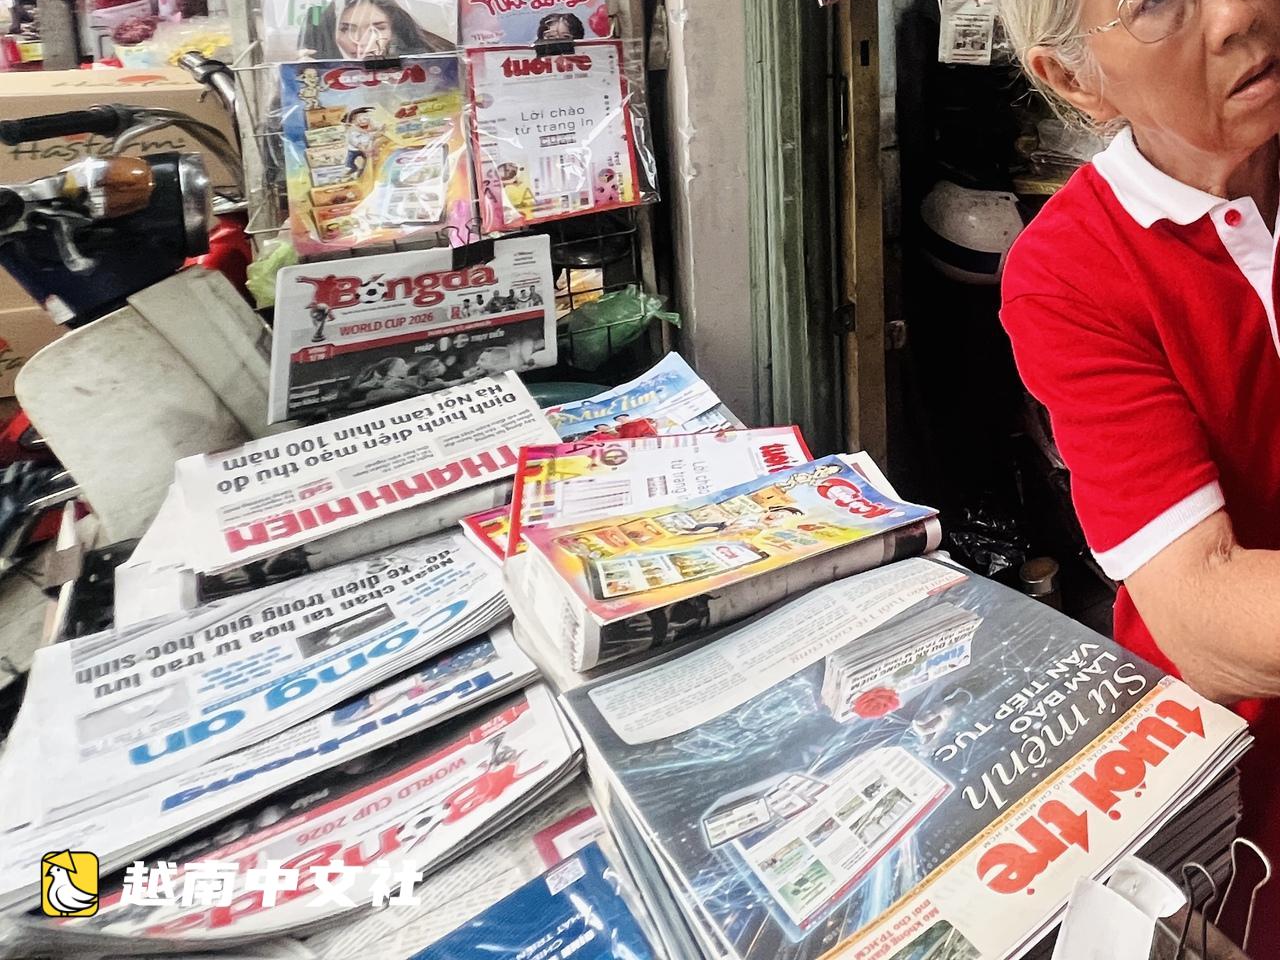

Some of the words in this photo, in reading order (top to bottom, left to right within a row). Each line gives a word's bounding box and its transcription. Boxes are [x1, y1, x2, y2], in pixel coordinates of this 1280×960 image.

[537, 120, 576, 133] trang
[550, 106, 585, 119] chào
[339, 320, 382, 337] WORLD
[384, 317, 406, 332] CUP
[408, 313, 434, 326] 2026
[286, 439, 324, 457] 100
[357, 444, 518, 510] THANH
[1069, 699, 1206, 821] tuổi
[398, 758, 467, 800] WORLD
[352, 794, 392, 822] CUP
[297, 814, 347, 845] 2026
[977, 799, 1089, 896] trẻ
